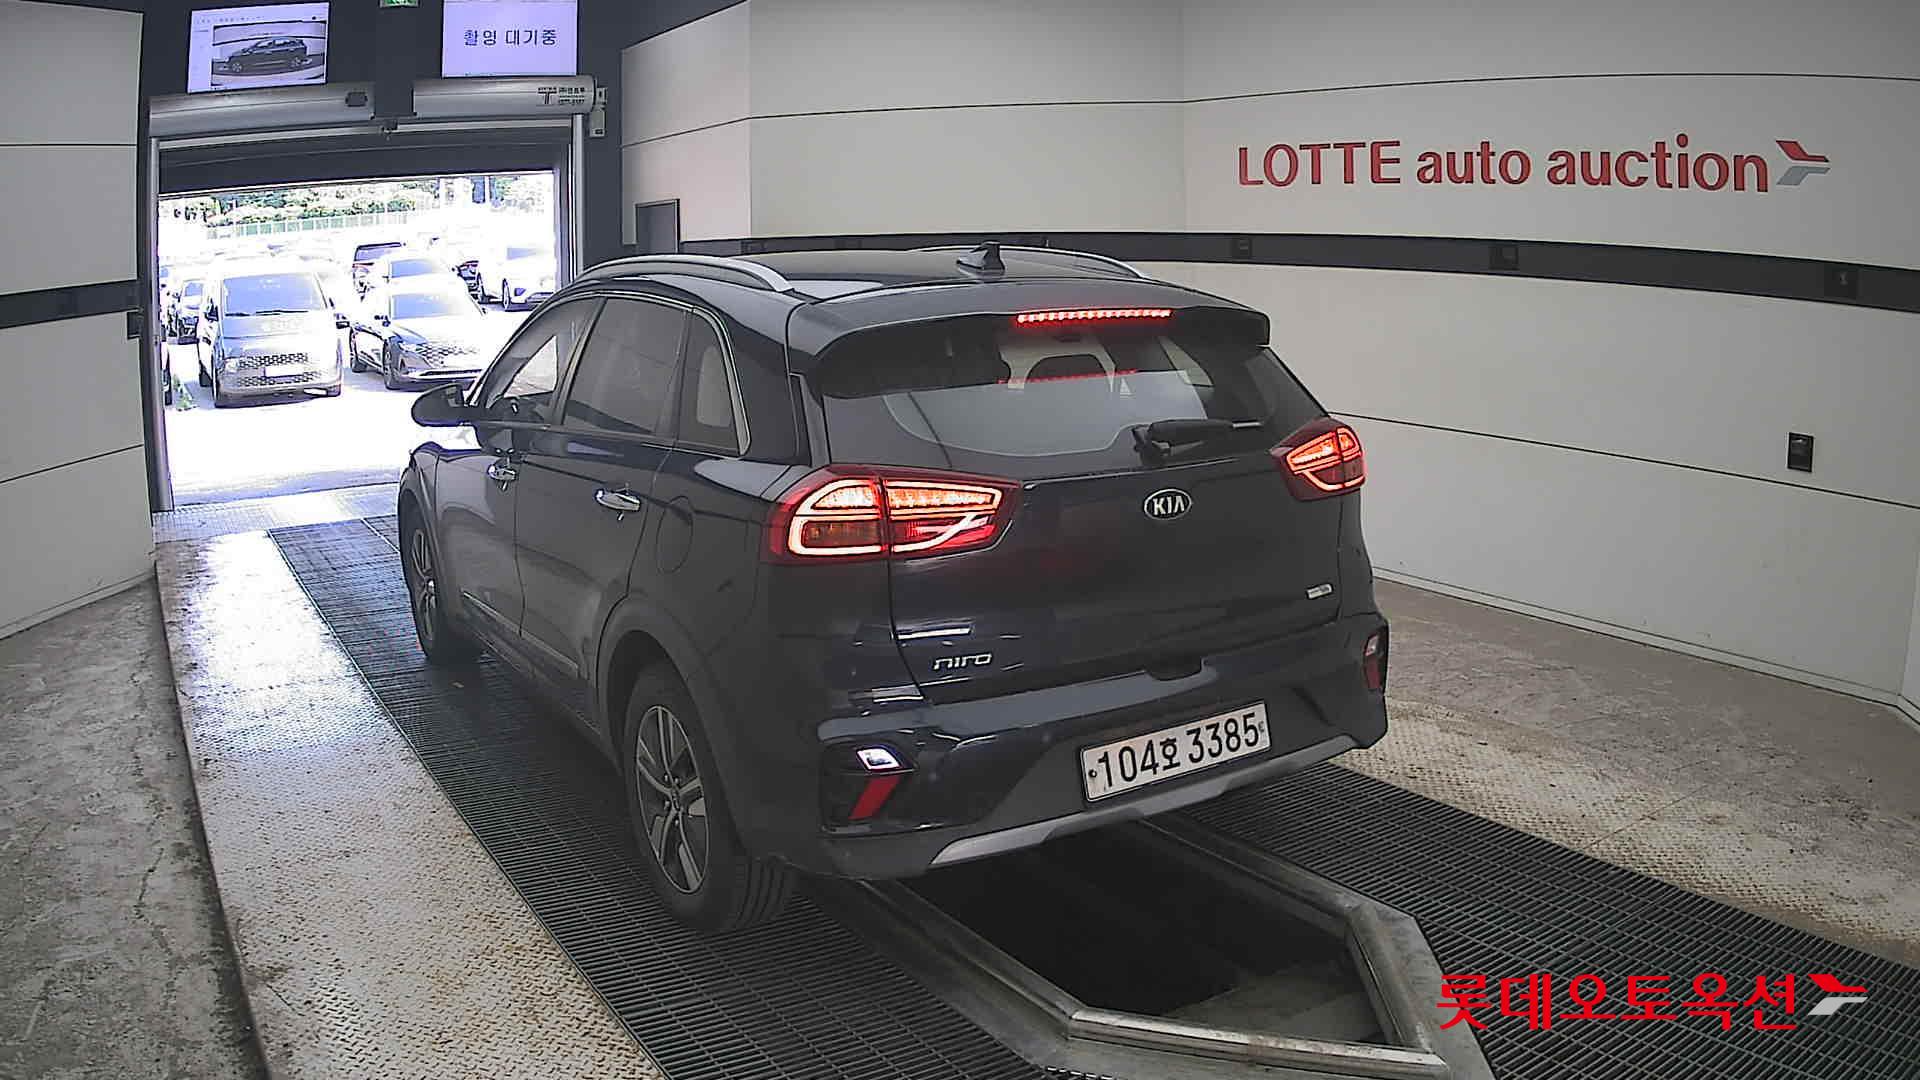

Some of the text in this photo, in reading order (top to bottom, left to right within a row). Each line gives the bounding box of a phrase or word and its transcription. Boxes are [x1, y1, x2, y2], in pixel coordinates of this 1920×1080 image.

[505, 29, 557, 46] 대기중
[1238, 133, 1768, 192] LOTTE auto auction
[1152, 495, 1185, 516] KIA
